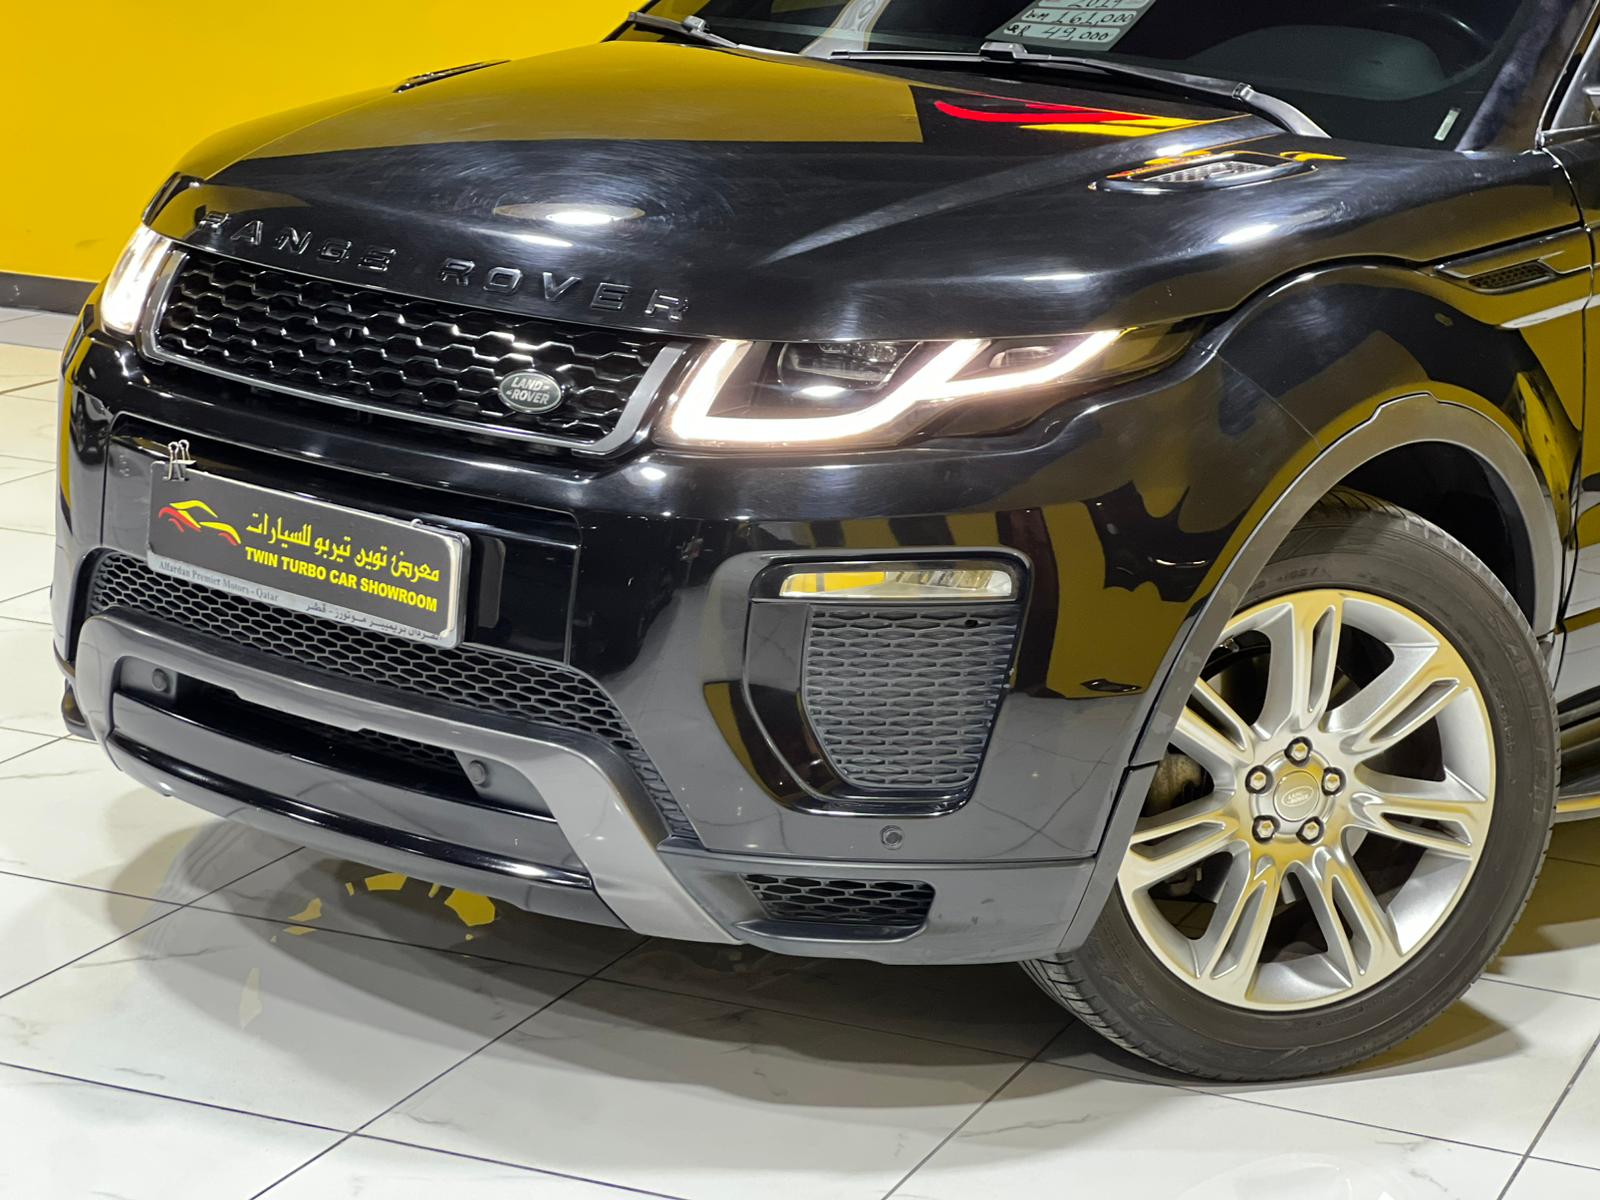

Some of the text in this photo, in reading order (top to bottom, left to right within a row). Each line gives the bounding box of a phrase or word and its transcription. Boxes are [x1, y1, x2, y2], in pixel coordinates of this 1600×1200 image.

[199, 212, 689, 321] RANGE ROVER
[511, 376, 544, 391] LAND
[511, 388, 550, 405] ROVER
[245, 512, 440, 583] معرض توين تيربو للسيارات
[245, 546, 438, 613] TWIN TURBO CAR SHOWROOM
